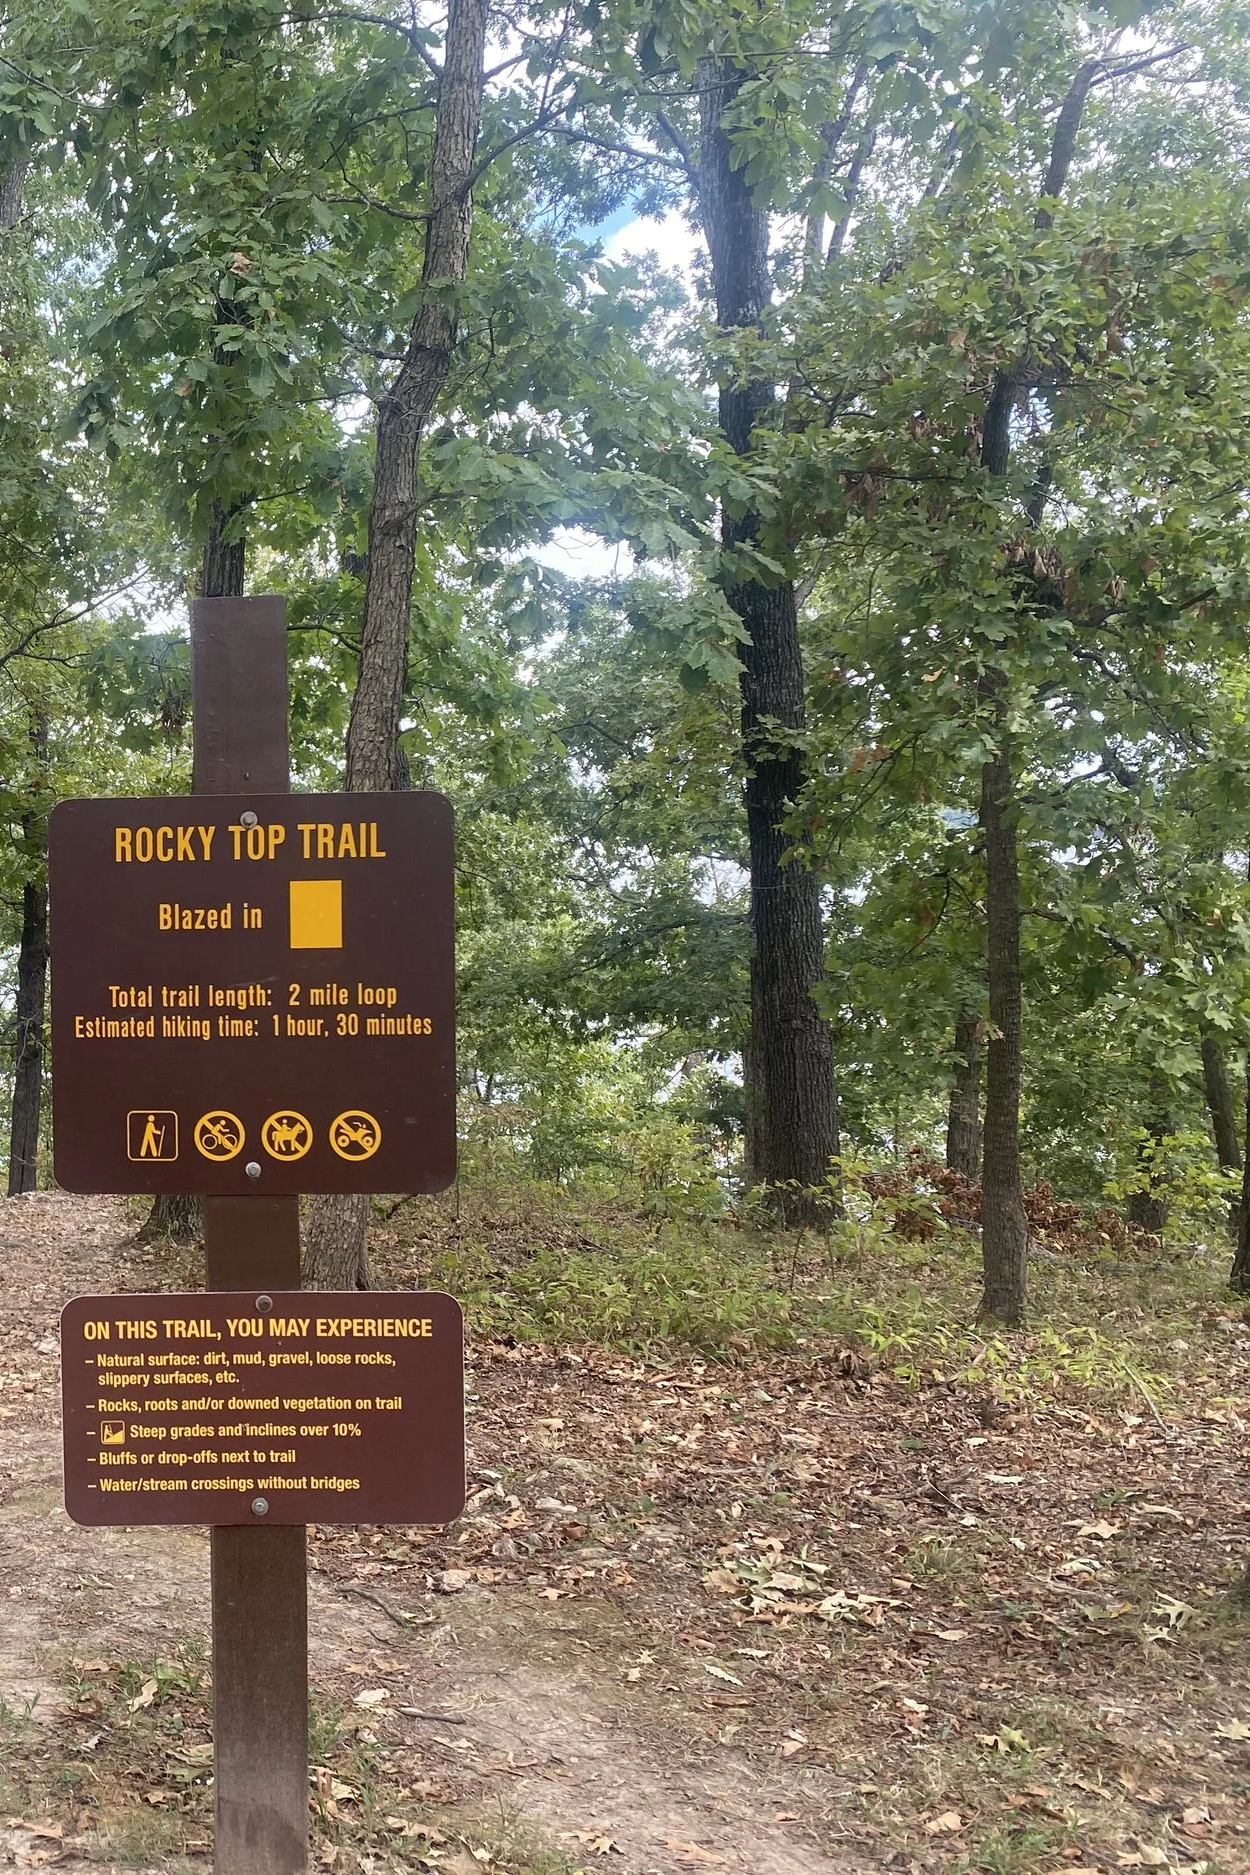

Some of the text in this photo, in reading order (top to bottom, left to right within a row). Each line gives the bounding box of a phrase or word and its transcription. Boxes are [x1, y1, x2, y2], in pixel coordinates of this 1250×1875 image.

[115, 822, 386, 862] ROCKY TOP TRAIL
[159, 902, 262, 930] Blazed in
[108, 982, 397, 1010] Total trail length: 2 mile loop
[75, 1013, 432, 1041] Estimated hiking time: 1 hour, 30 minutes
[83, 1318, 433, 1341] ON THIS TRAIL, YOU MAY EXPERIENCE
[97, 1352, 145, 1368] Natural
[147, 1352, 200, 1367] surface:
[203, 1351, 230, 1368] dirt,
[232, 1350, 266, 1367] mud,
[268, 1350, 314, 1368] gravel,
[316, 1351, 352, 1366] loose
[354, 1351, 396, 1367] rocks,
[98, 1370, 240, 1388] slippery surfaces, etc.
[98, 1398, 142, 1414] Rocks,
[144, 1398, 179, 1412] roots
[181, 1396, 225, 1411] and/or
[227, 1396, 280, 1411] downed
[282, 1396, 352, 1413] vegetation
[355, 1398, 372, 1411] on
[374, 1396, 402, 1410] trail
[129, 1424, 167, 1441] Steep
[170, 1423, 215, 1441] grades
[218, 1423, 243, 1437] and
[245, 1422, 297, 1437] inclines
[299, 1425, 330, 1438] over
[332, 1422, 362, 1438] 10%
[99, 1451, 138, 1466] Bluffs
[140, 1453, 155, 1465] or
[157, 1449, 218, 1467] drop-offs
[221, 1450, 250, 1464] next
[253, 1450, 267, 1464] to
[269, 1449, 296, 1464] trail
[99, 1477, 188, 1492] Water/stream
[190, 1475, 254, 1493] crossings
[257, 1475, 308, 1490] without
[310, 1475, 361, 1492] bridges
